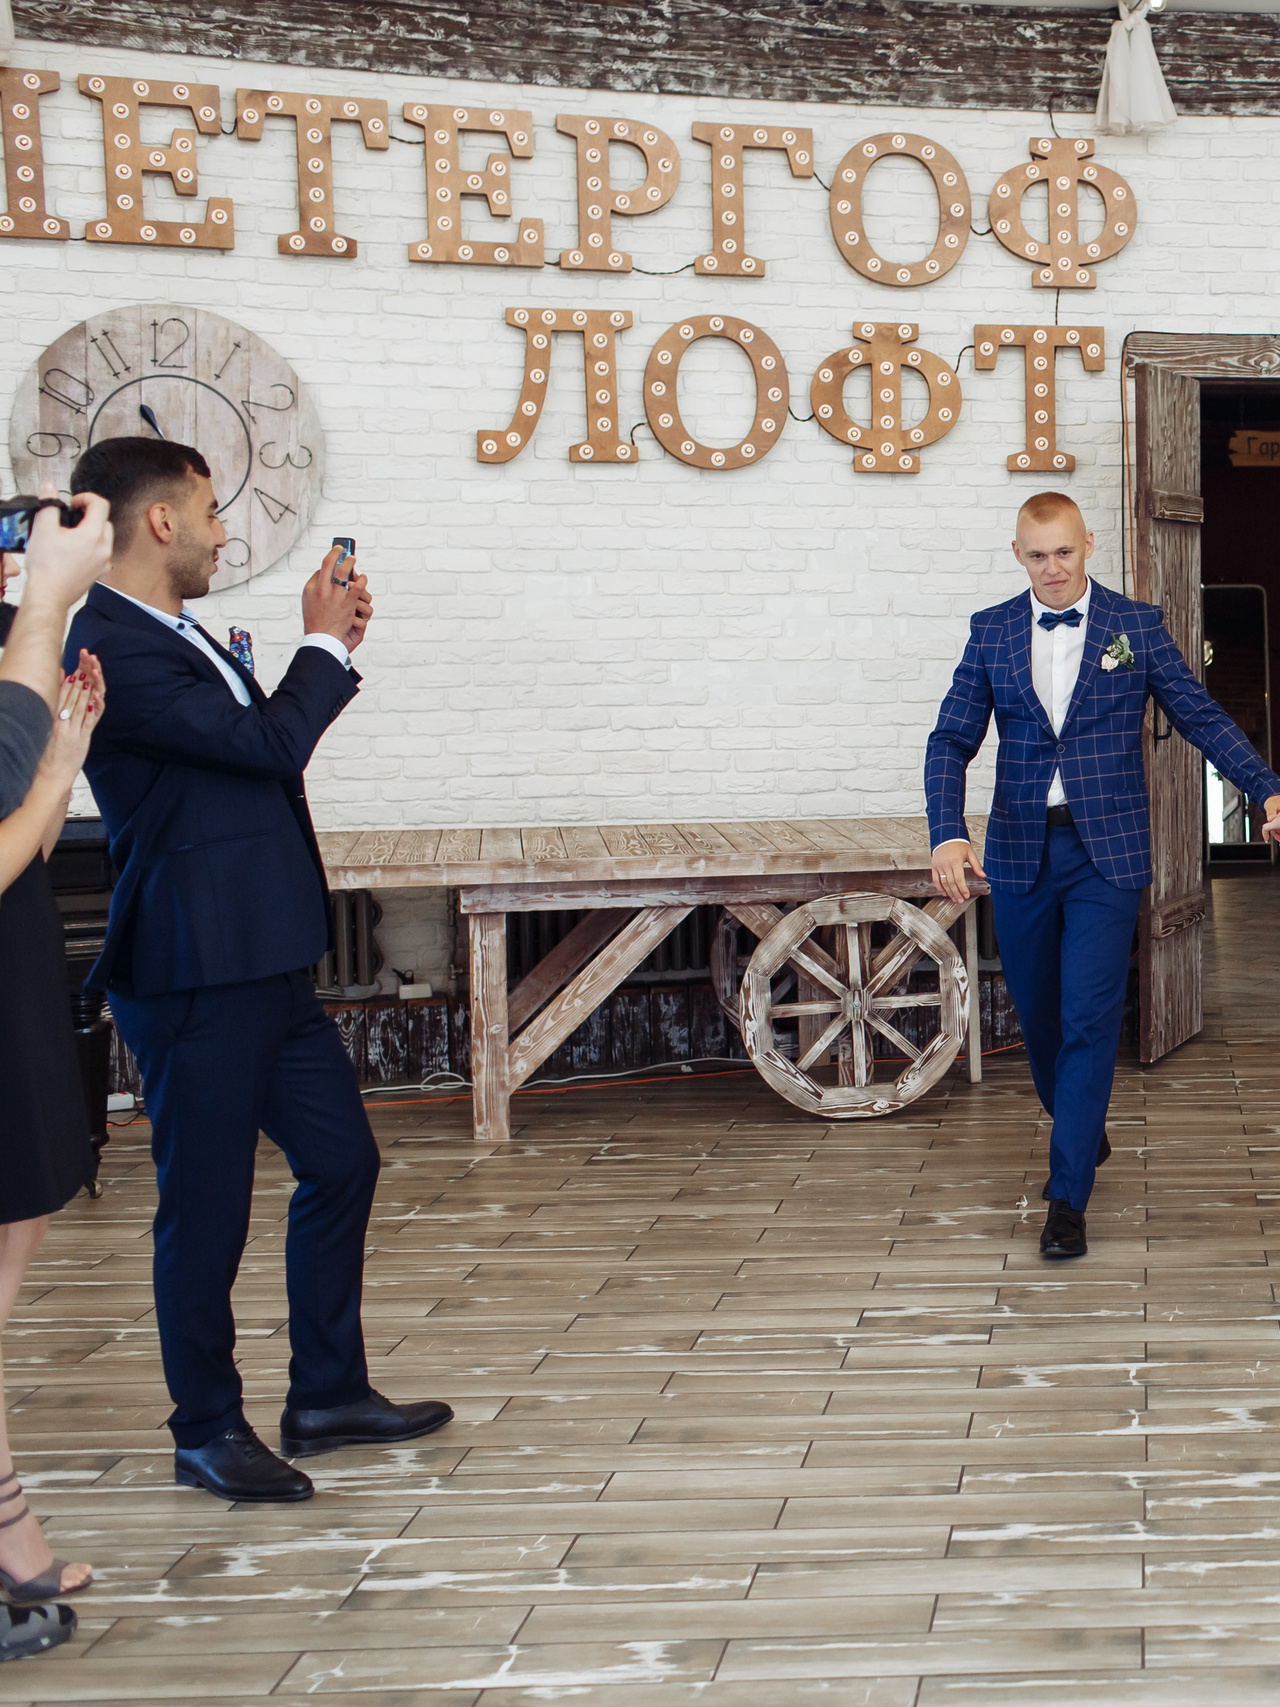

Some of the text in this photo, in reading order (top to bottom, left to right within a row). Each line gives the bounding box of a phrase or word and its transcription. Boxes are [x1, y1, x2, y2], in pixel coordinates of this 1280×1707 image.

[91, 329, 131, 379] 11
[151, 318, 190, 368] 12
[39, 368, 95, 414] 10
[241, 384, 295, 424] 2
[477, 308, 1105, 472] ЛОФТ
[27, 432, 81, 459] 9
[259, 440, 312, 468] 3
[254, 487, 297, 524] 4
